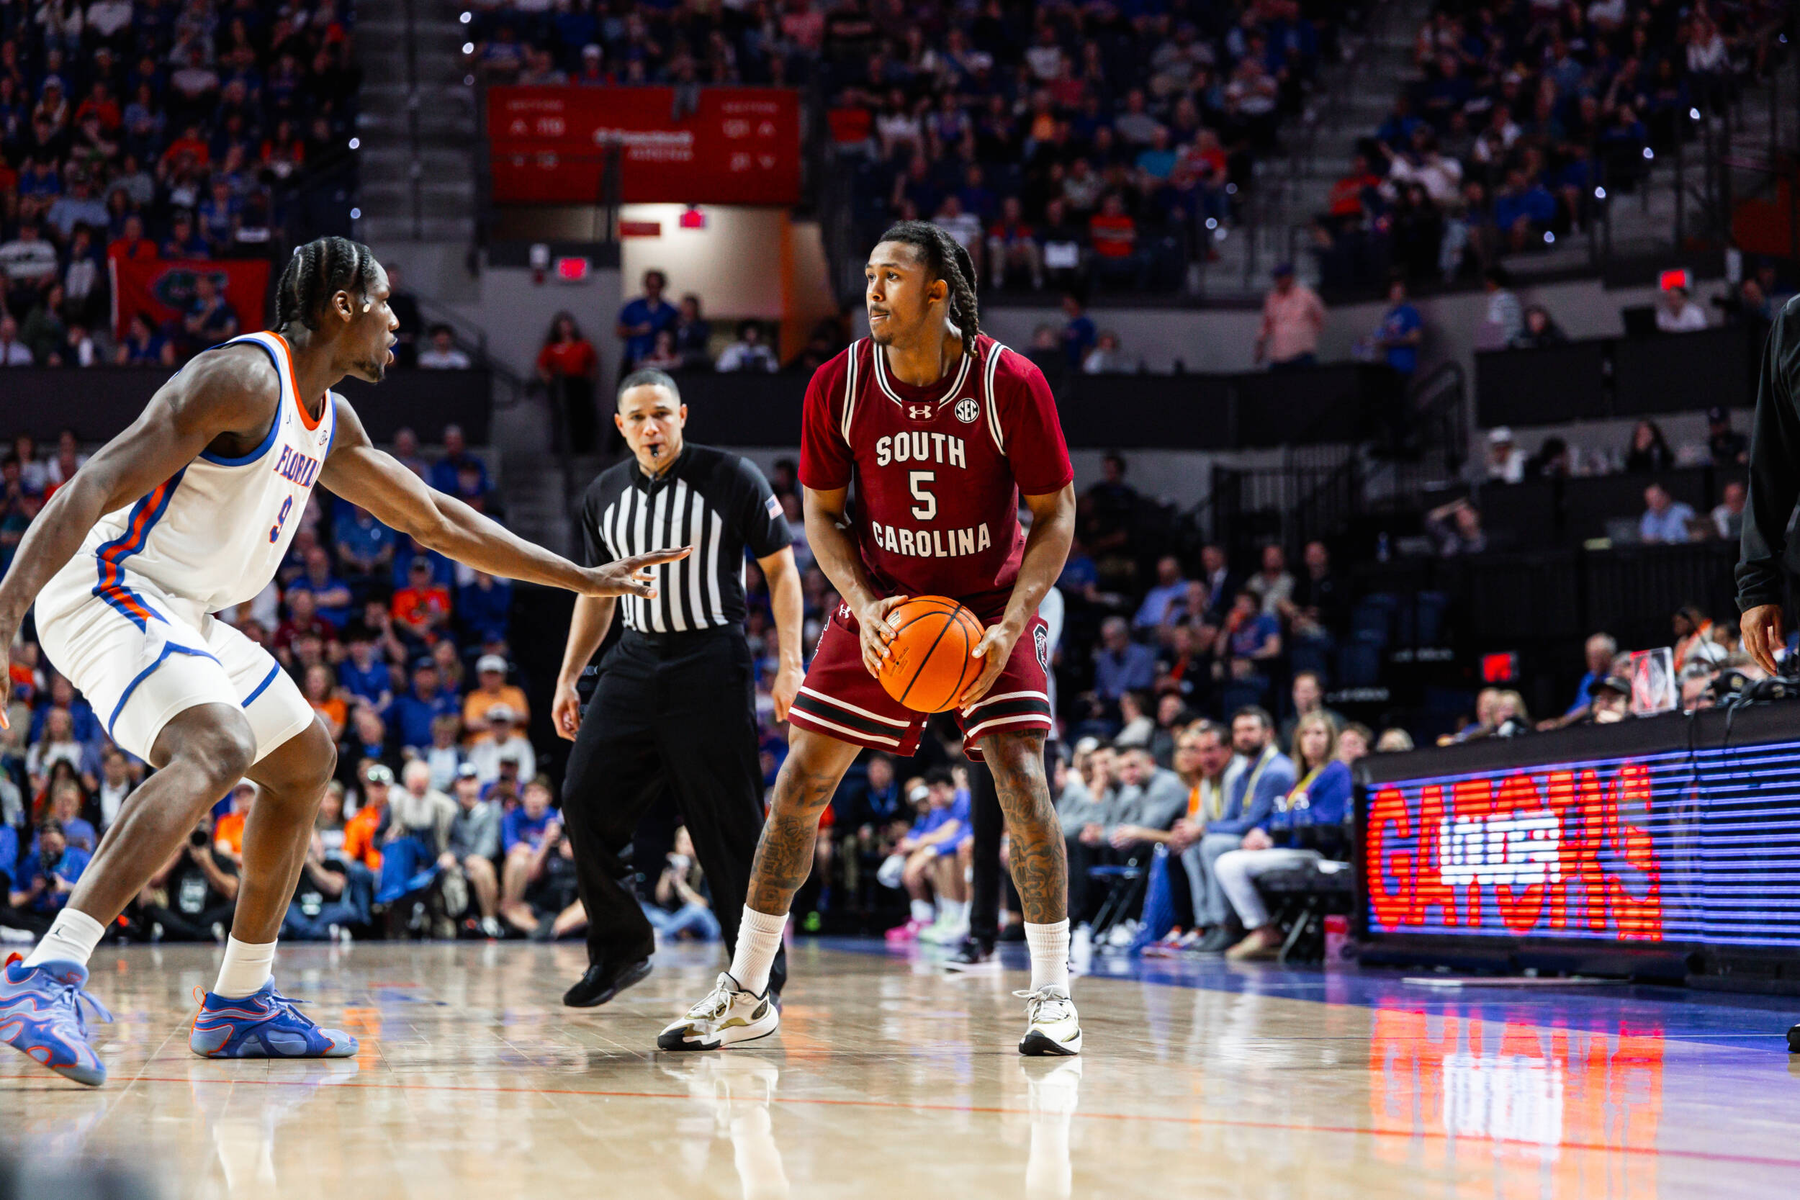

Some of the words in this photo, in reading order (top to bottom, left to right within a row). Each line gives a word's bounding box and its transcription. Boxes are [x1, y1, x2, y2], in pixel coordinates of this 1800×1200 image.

[956, 400, 979, 422] SEC
[876, 431, 967, 470] SOUTH
[909, 471, 937, 521] 5
[269, 494, 293, 544] 9
[872, 520, 991, 558] CAROLINA
